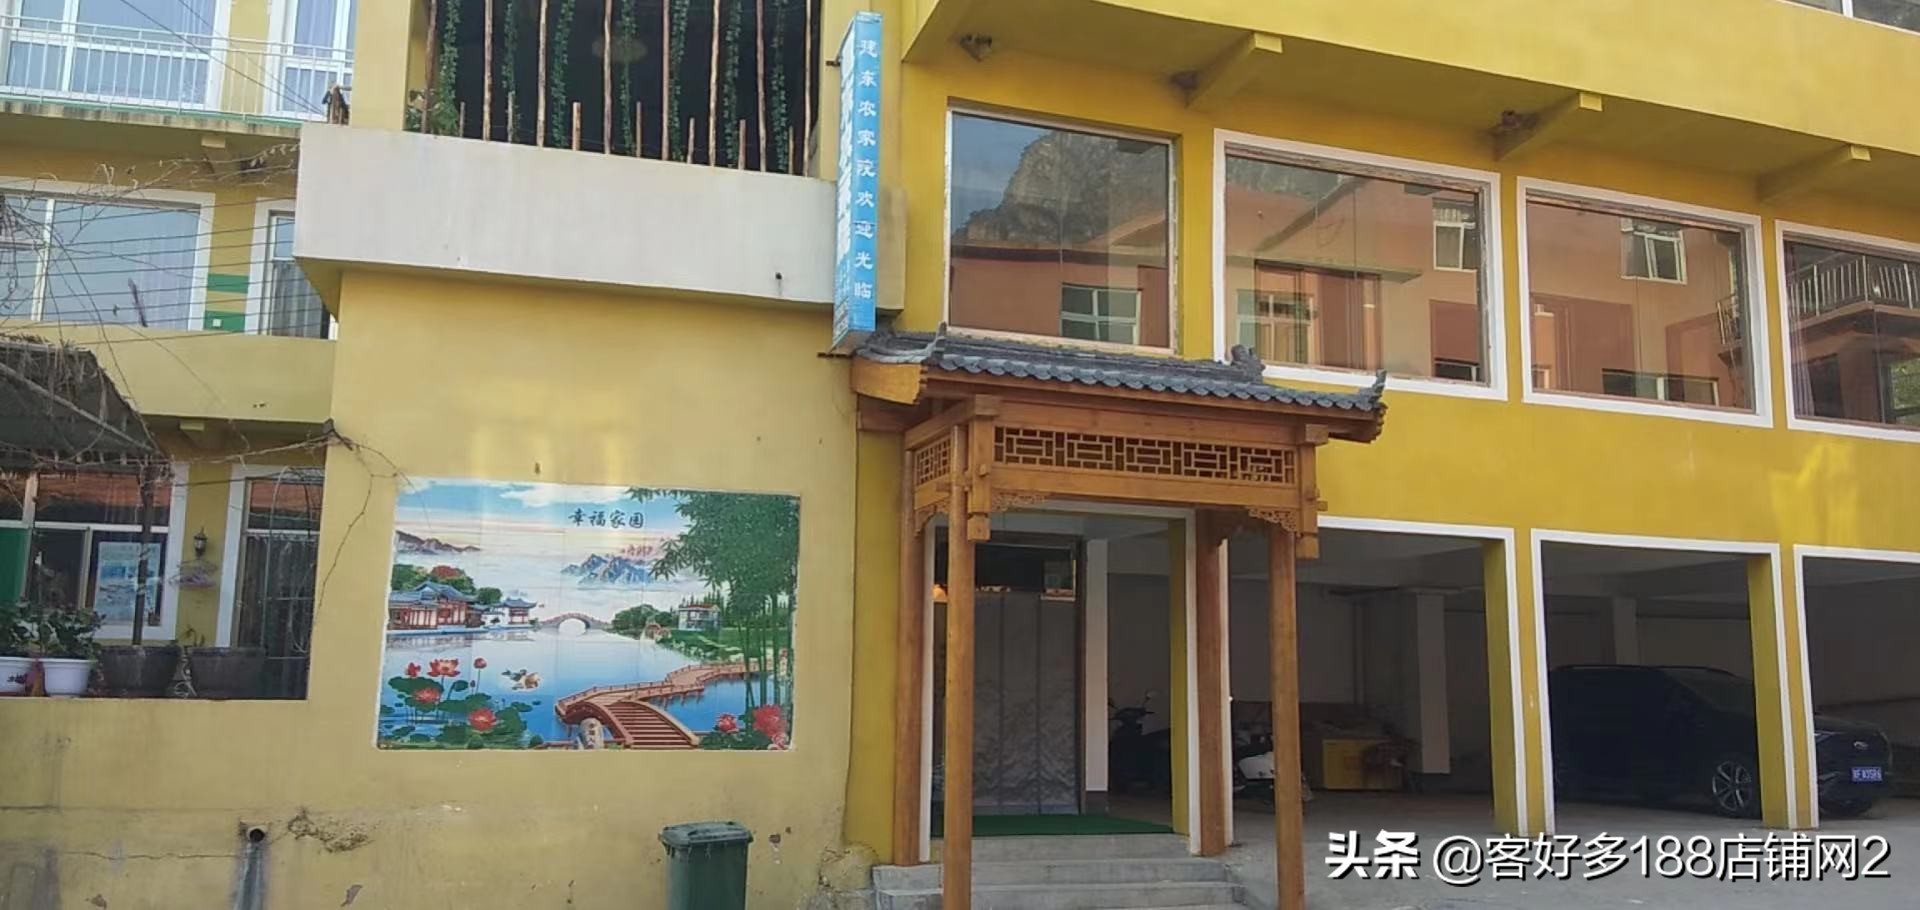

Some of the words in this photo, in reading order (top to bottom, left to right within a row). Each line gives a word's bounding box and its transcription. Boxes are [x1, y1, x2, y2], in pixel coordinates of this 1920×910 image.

[854, 39, 879, 299] 建东农家院欢迎光临
[568, 507, 644, 529] 幸福家园
